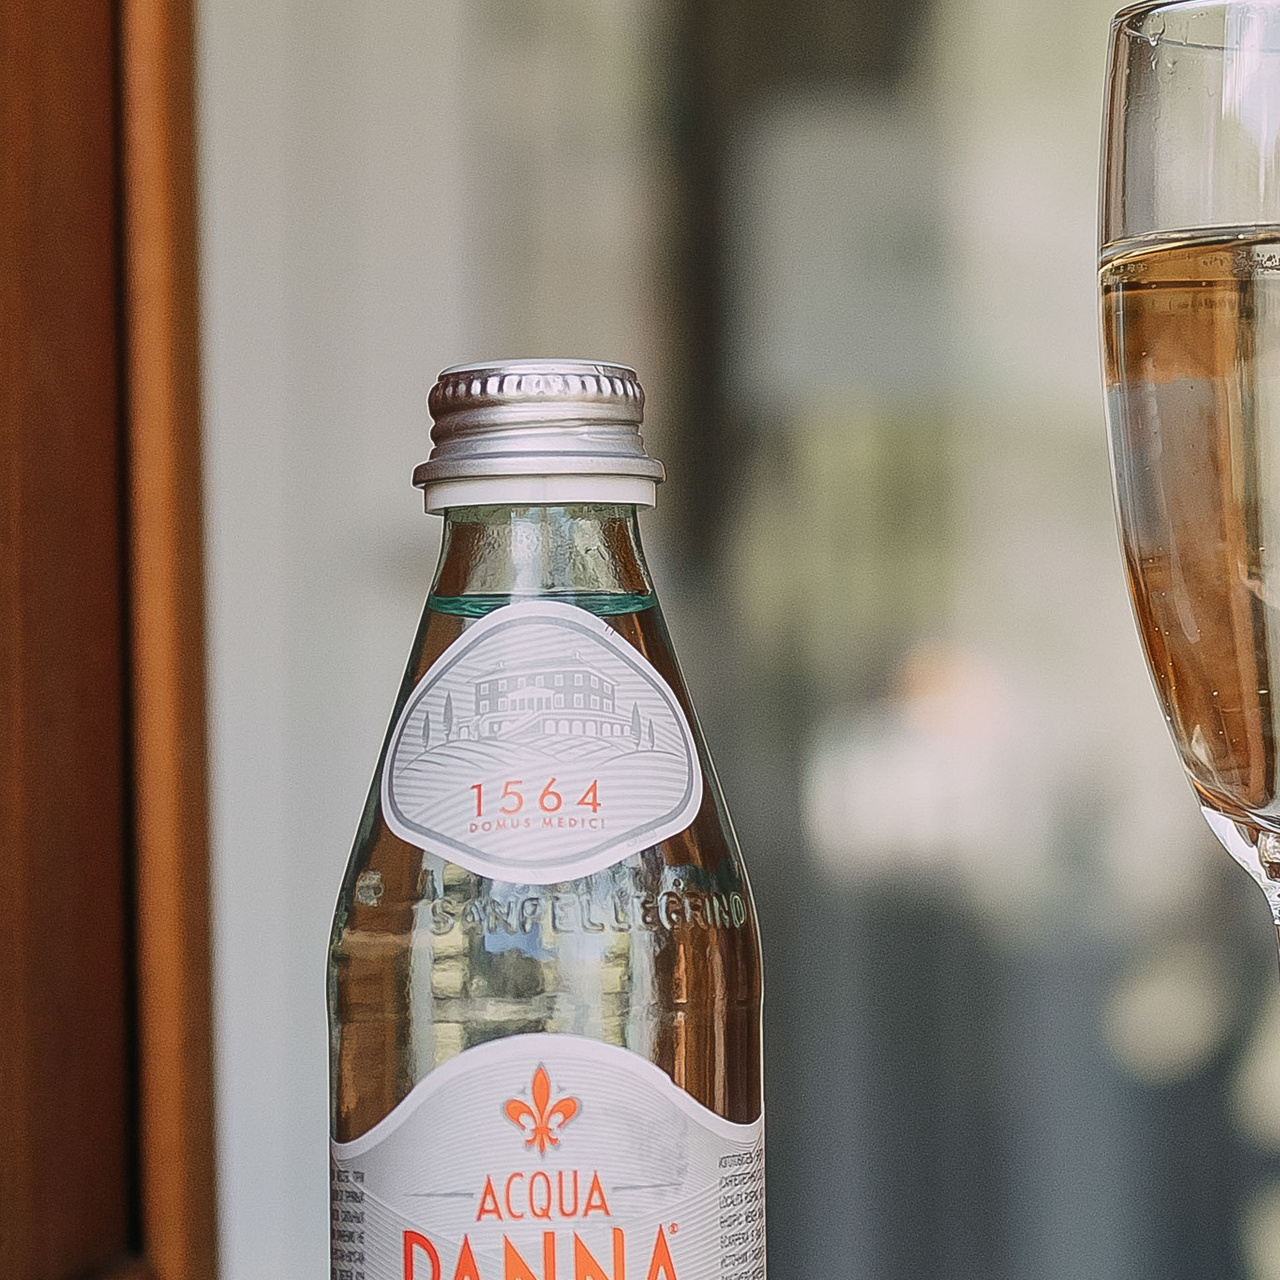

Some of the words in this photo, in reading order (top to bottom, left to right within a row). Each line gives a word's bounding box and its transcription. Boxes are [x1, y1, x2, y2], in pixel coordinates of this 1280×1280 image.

[469, 776, 603, 818] 1564
[469, 818, 532, 834] DOMUS
[541, 818, 606, 831] MEDICI
[475, 1169, 612, 1222] ACQUA
